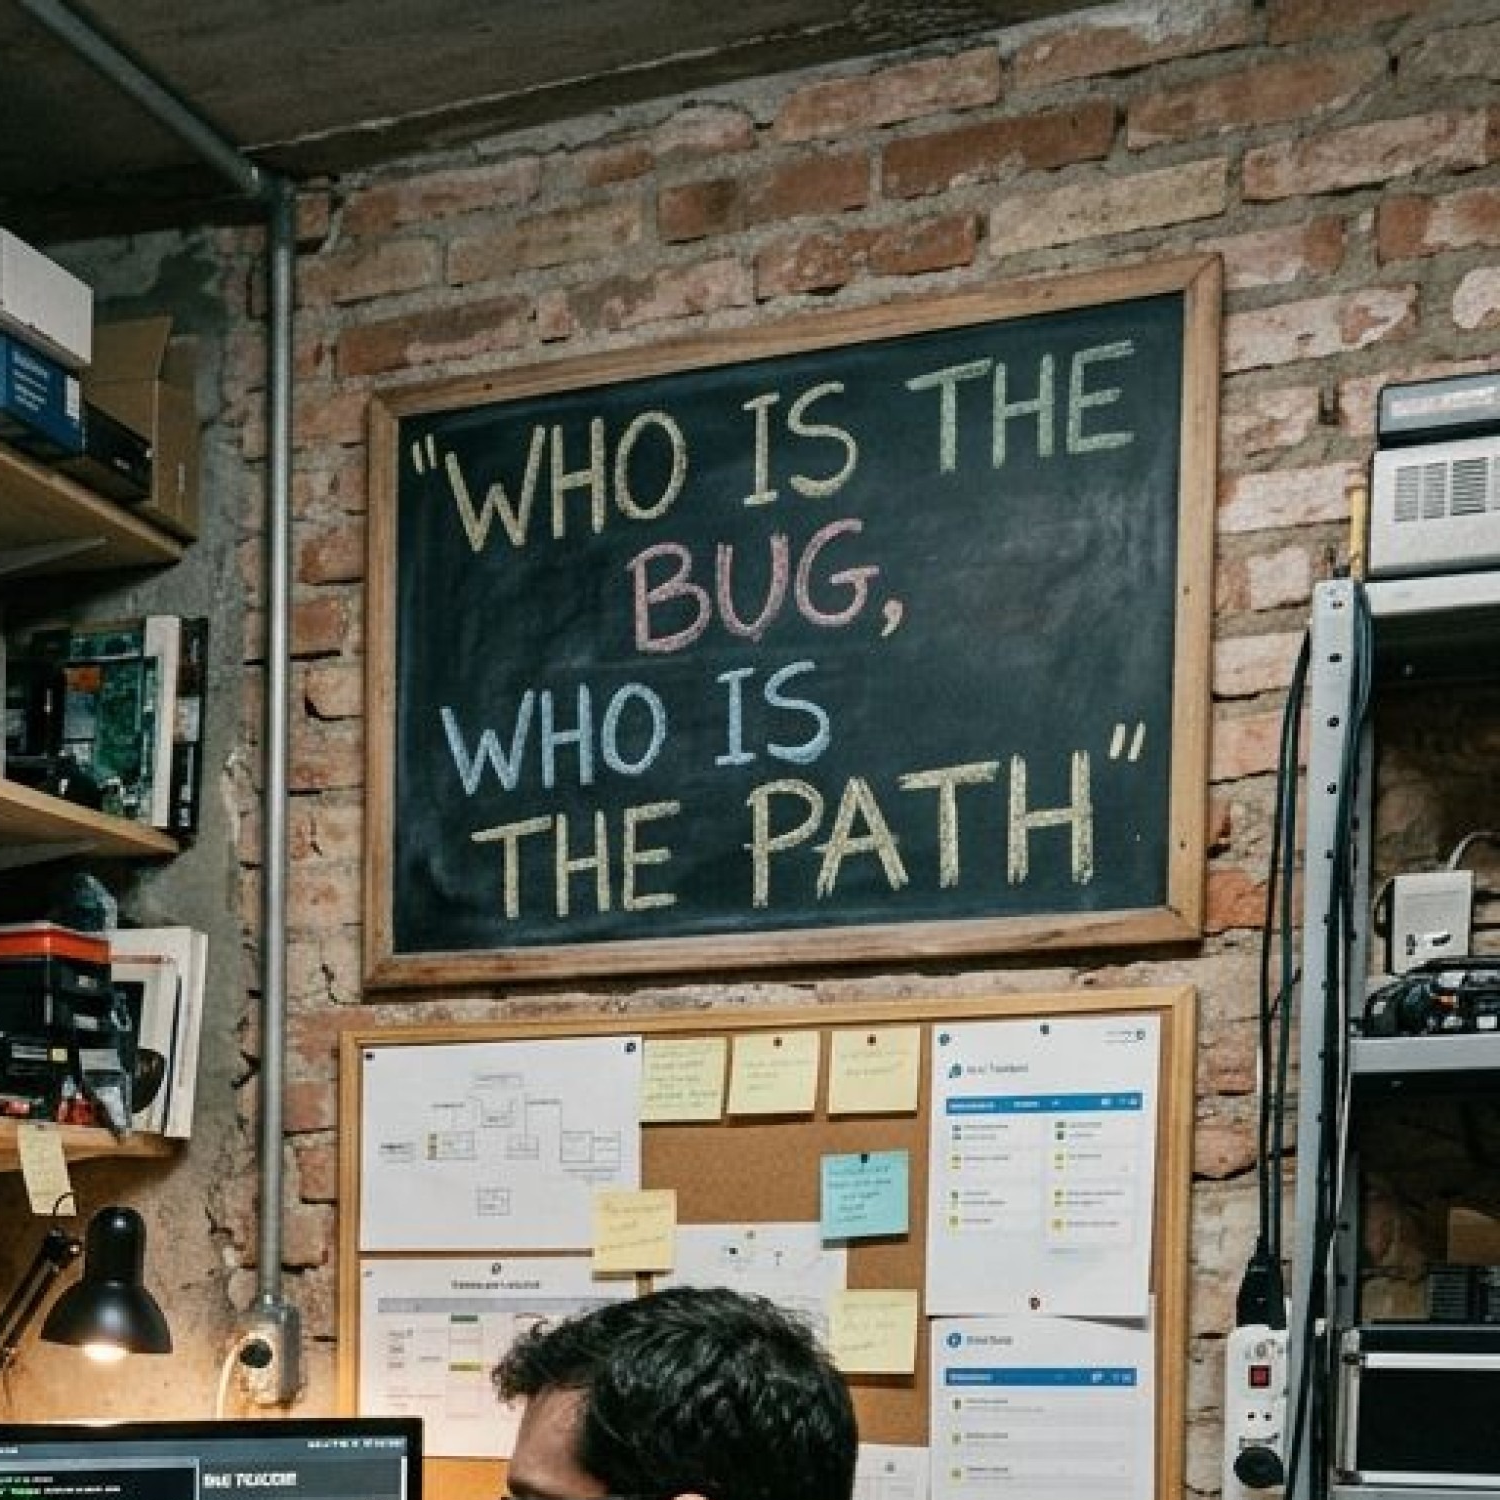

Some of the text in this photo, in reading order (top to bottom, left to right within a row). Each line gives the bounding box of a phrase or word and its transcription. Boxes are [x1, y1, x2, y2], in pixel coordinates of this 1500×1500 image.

[413, 339, 1133, 552] "WHO IS THE
[630, 518, 902, 651] BUG,
[442, 662, 829, 794] WHO IS
[472, 722, 1147, 917] THE PATH"
